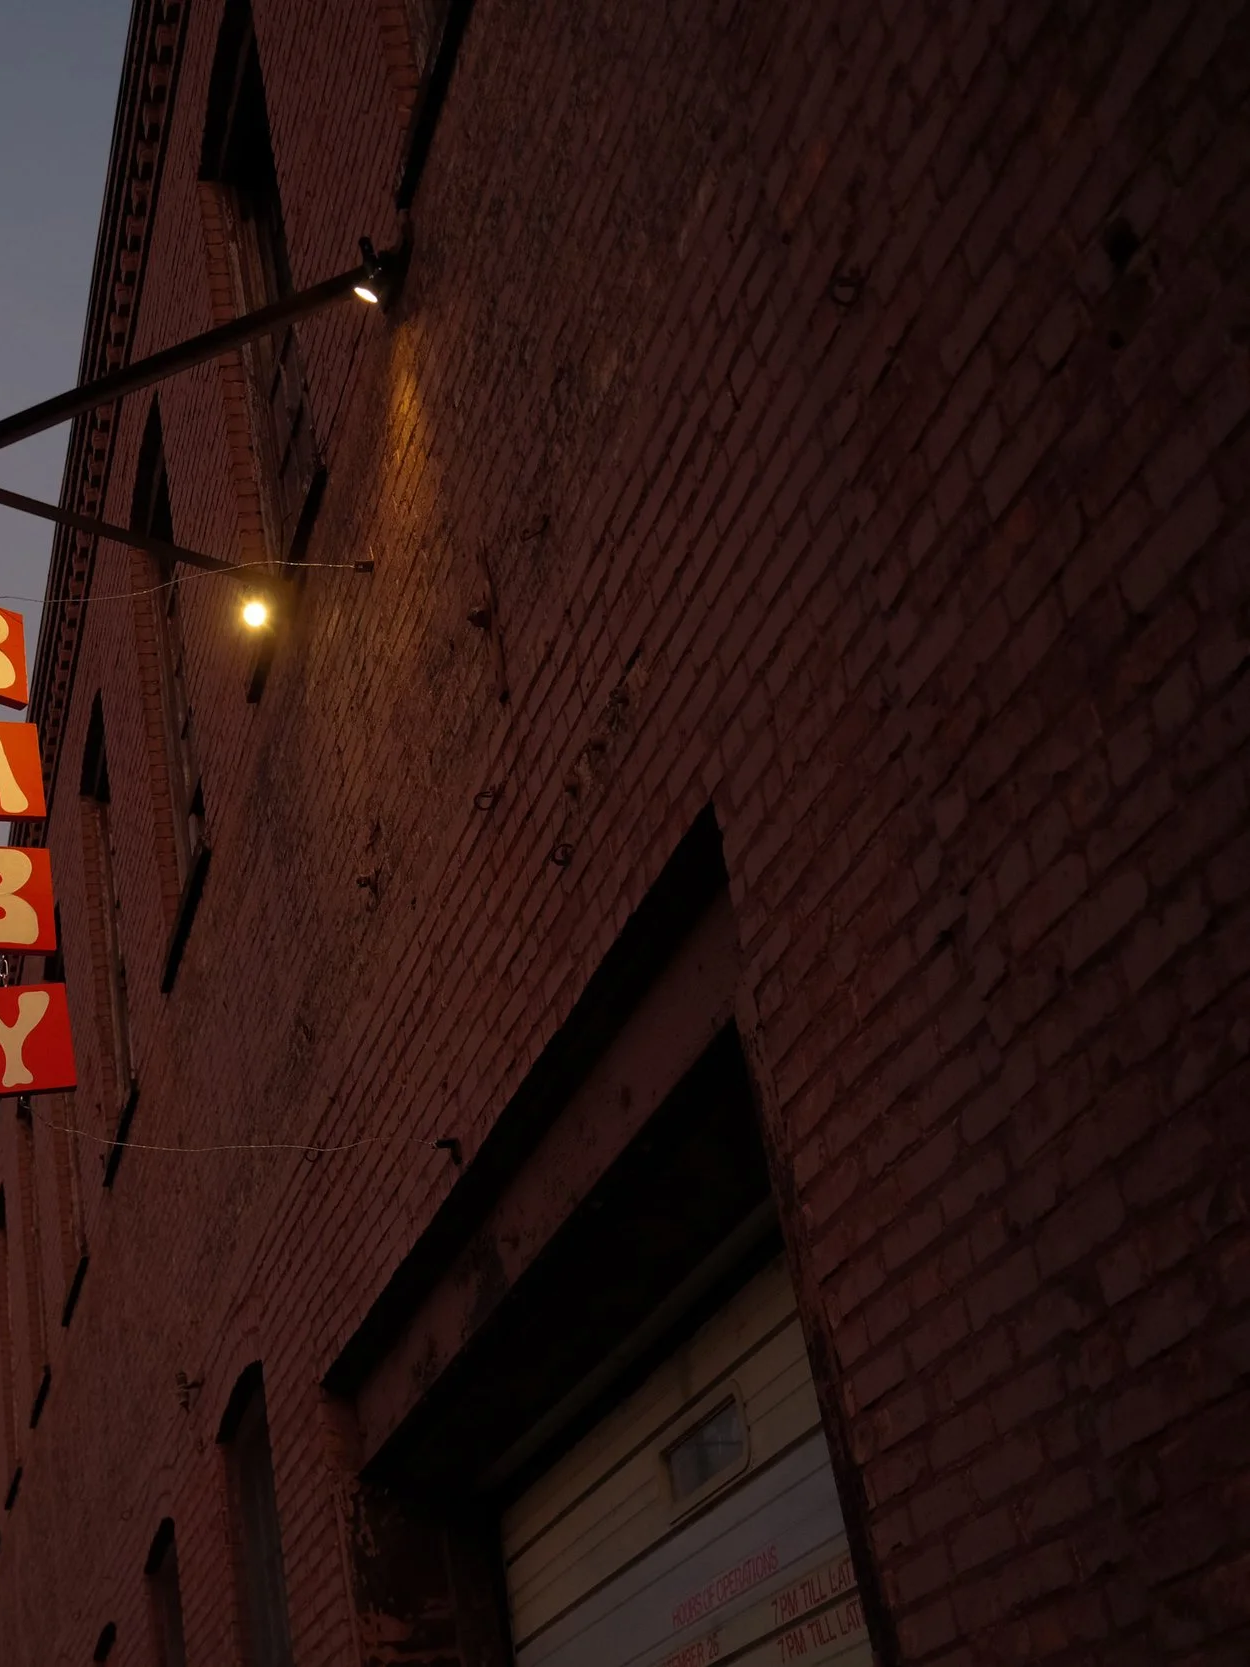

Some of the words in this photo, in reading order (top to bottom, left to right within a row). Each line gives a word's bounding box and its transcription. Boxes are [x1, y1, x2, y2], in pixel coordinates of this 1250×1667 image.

[672, 1592, 702, 1629] HOURS
[703, 1583, 715, 1610] OF
[716, 1544, 779, 1602] OPERATIONS
[800, 1574, 827, 1609] TILL
[828, 1557, 855, 1593] LAT
[807, 1615, 837, 1648] TILL
[836, 1599, 864, 1635] LAT
